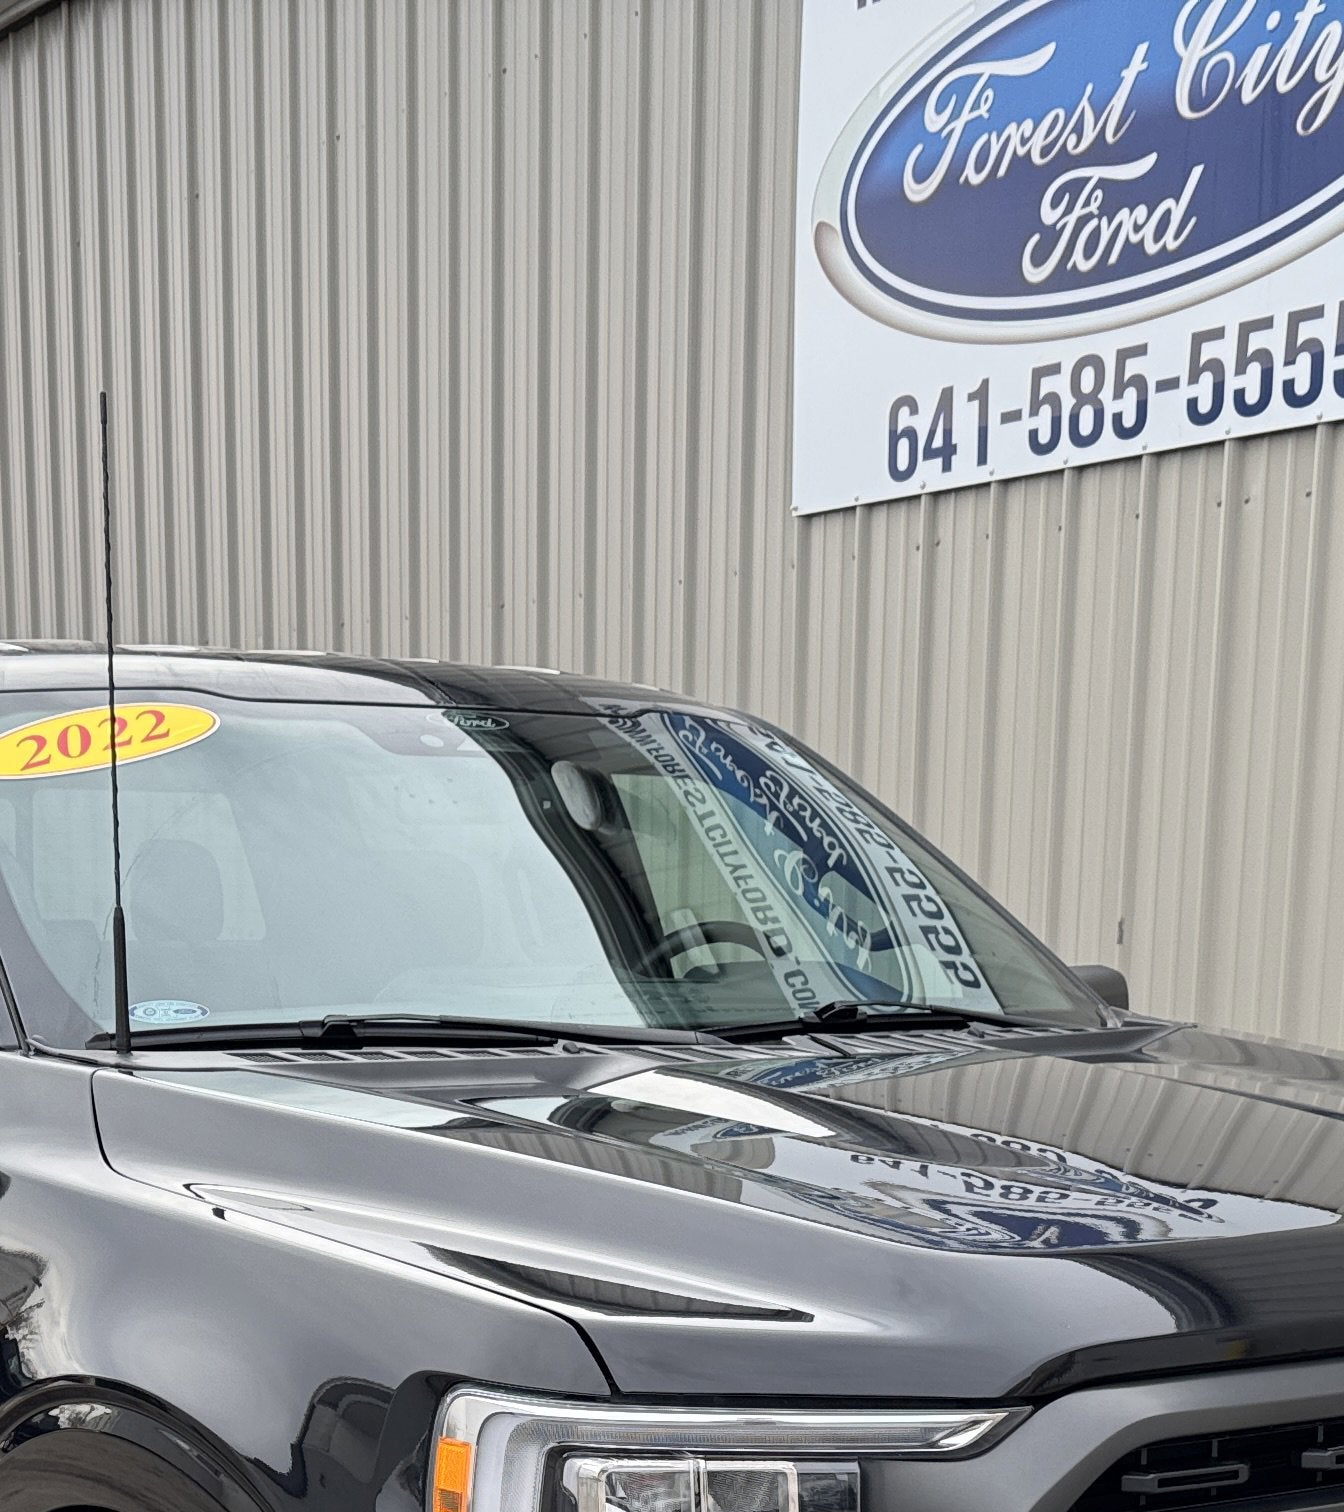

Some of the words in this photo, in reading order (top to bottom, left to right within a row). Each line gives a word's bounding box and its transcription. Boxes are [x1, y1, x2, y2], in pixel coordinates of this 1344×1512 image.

[903, 41, 1149, 203] Forest
[1021, 151, 1205, 285] Ford
[15, 709, 171, 772] 2022
